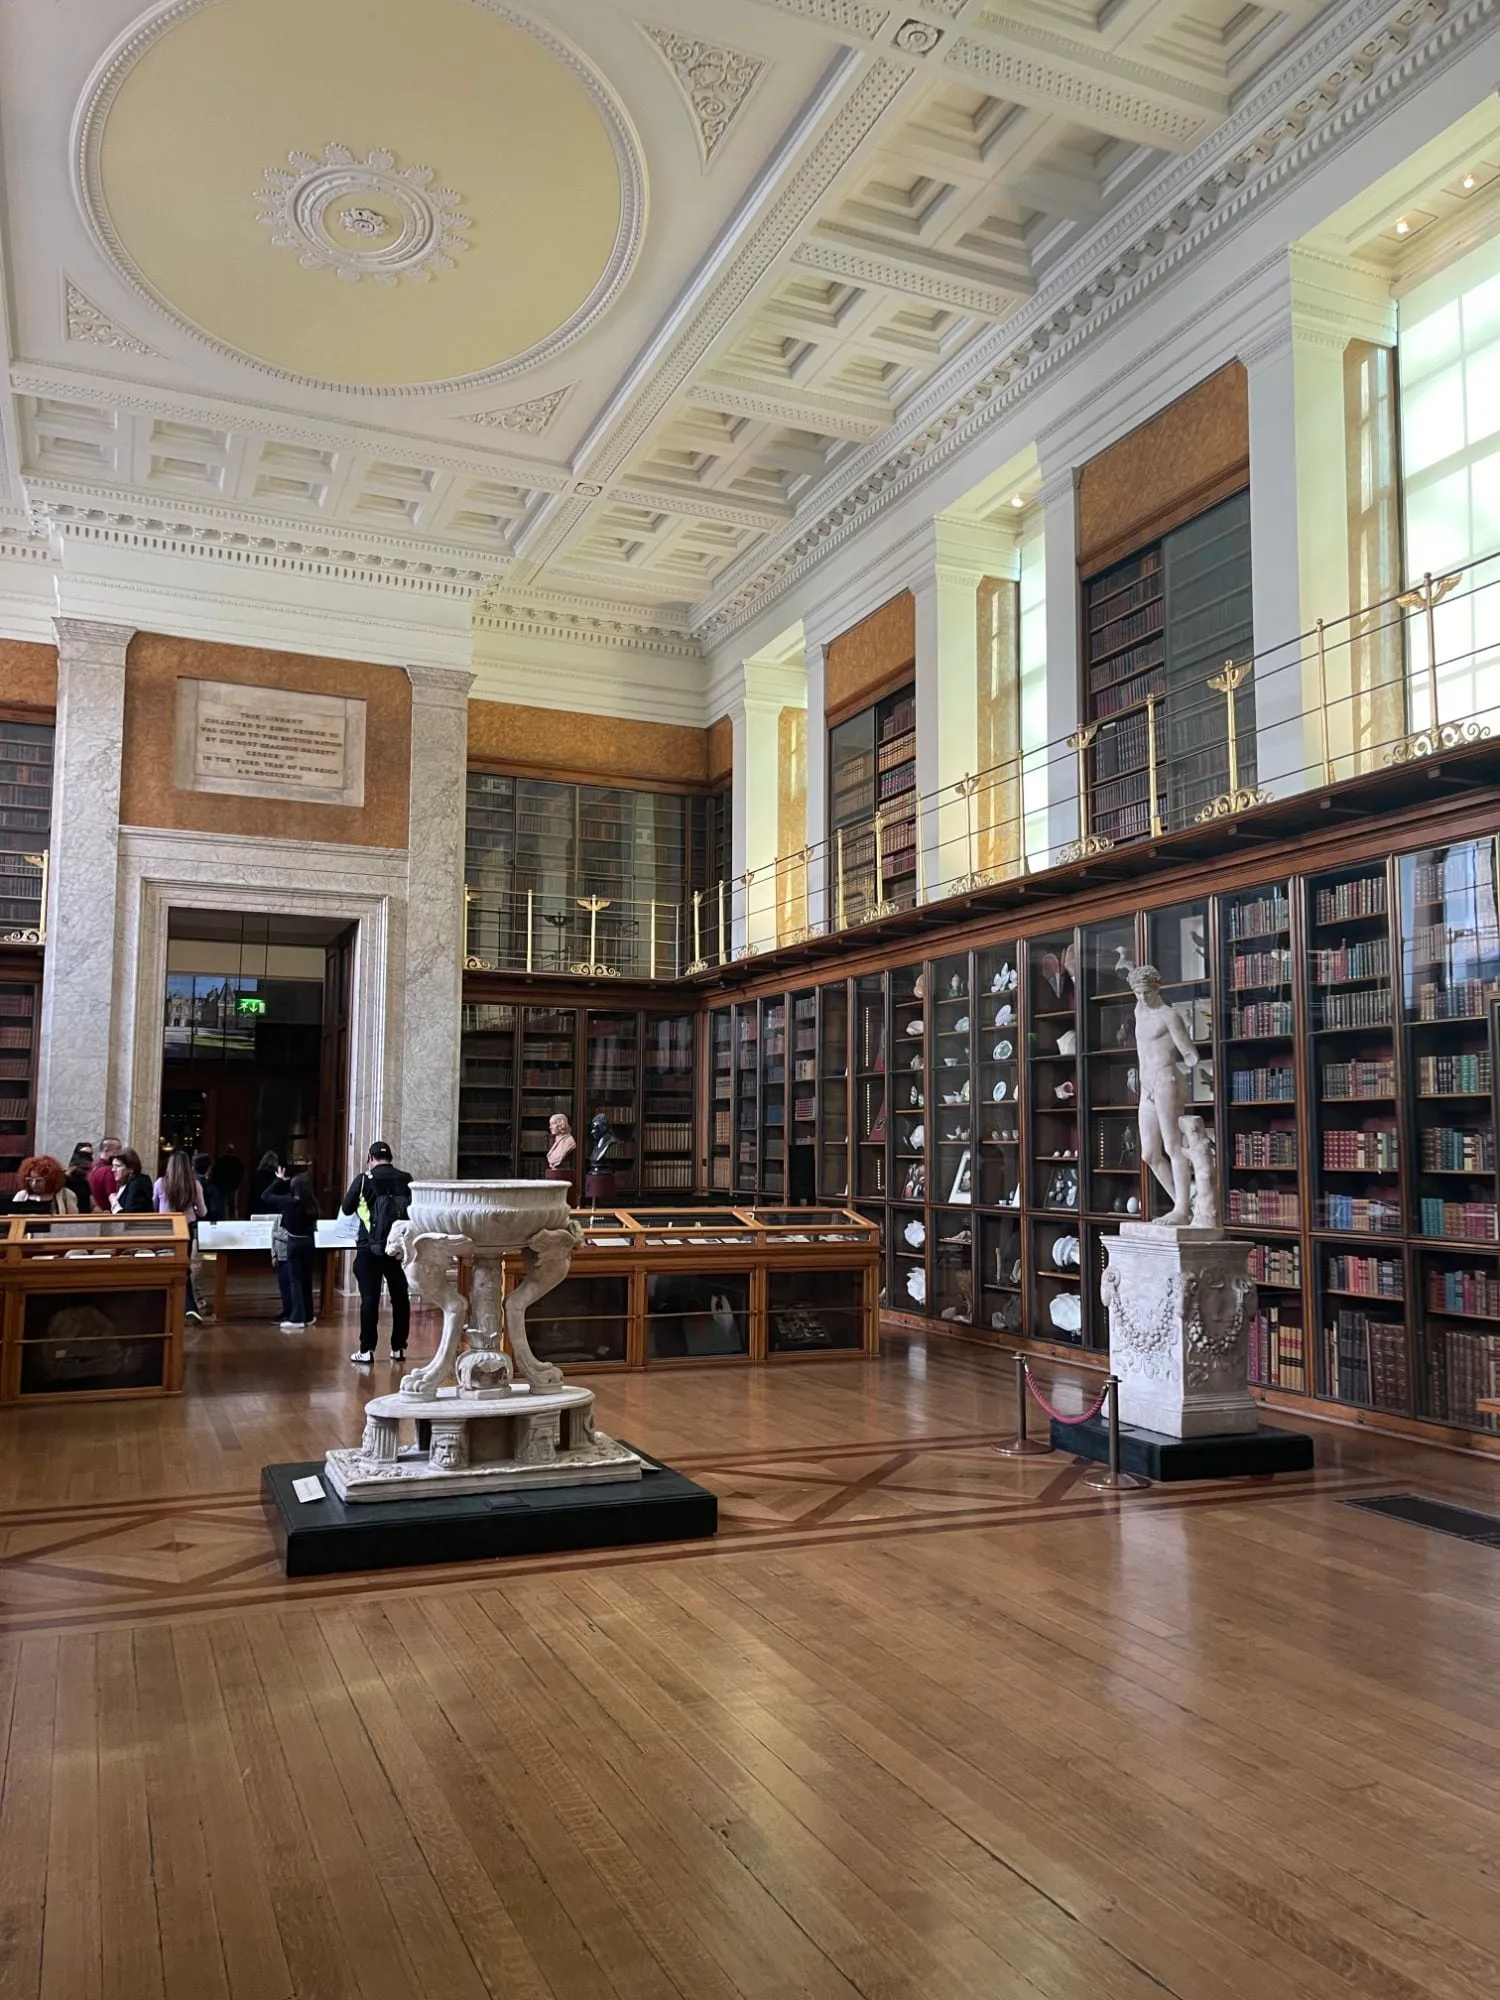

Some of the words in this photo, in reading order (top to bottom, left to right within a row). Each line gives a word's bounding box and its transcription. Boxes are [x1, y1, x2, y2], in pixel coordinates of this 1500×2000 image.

[205, 718, 253, 728] COLLECTED
[293, 728, 326, 737] GEORGE
[246, 750, 280, 759] GEORGE
[314, 767, 339, 775] REIGN
